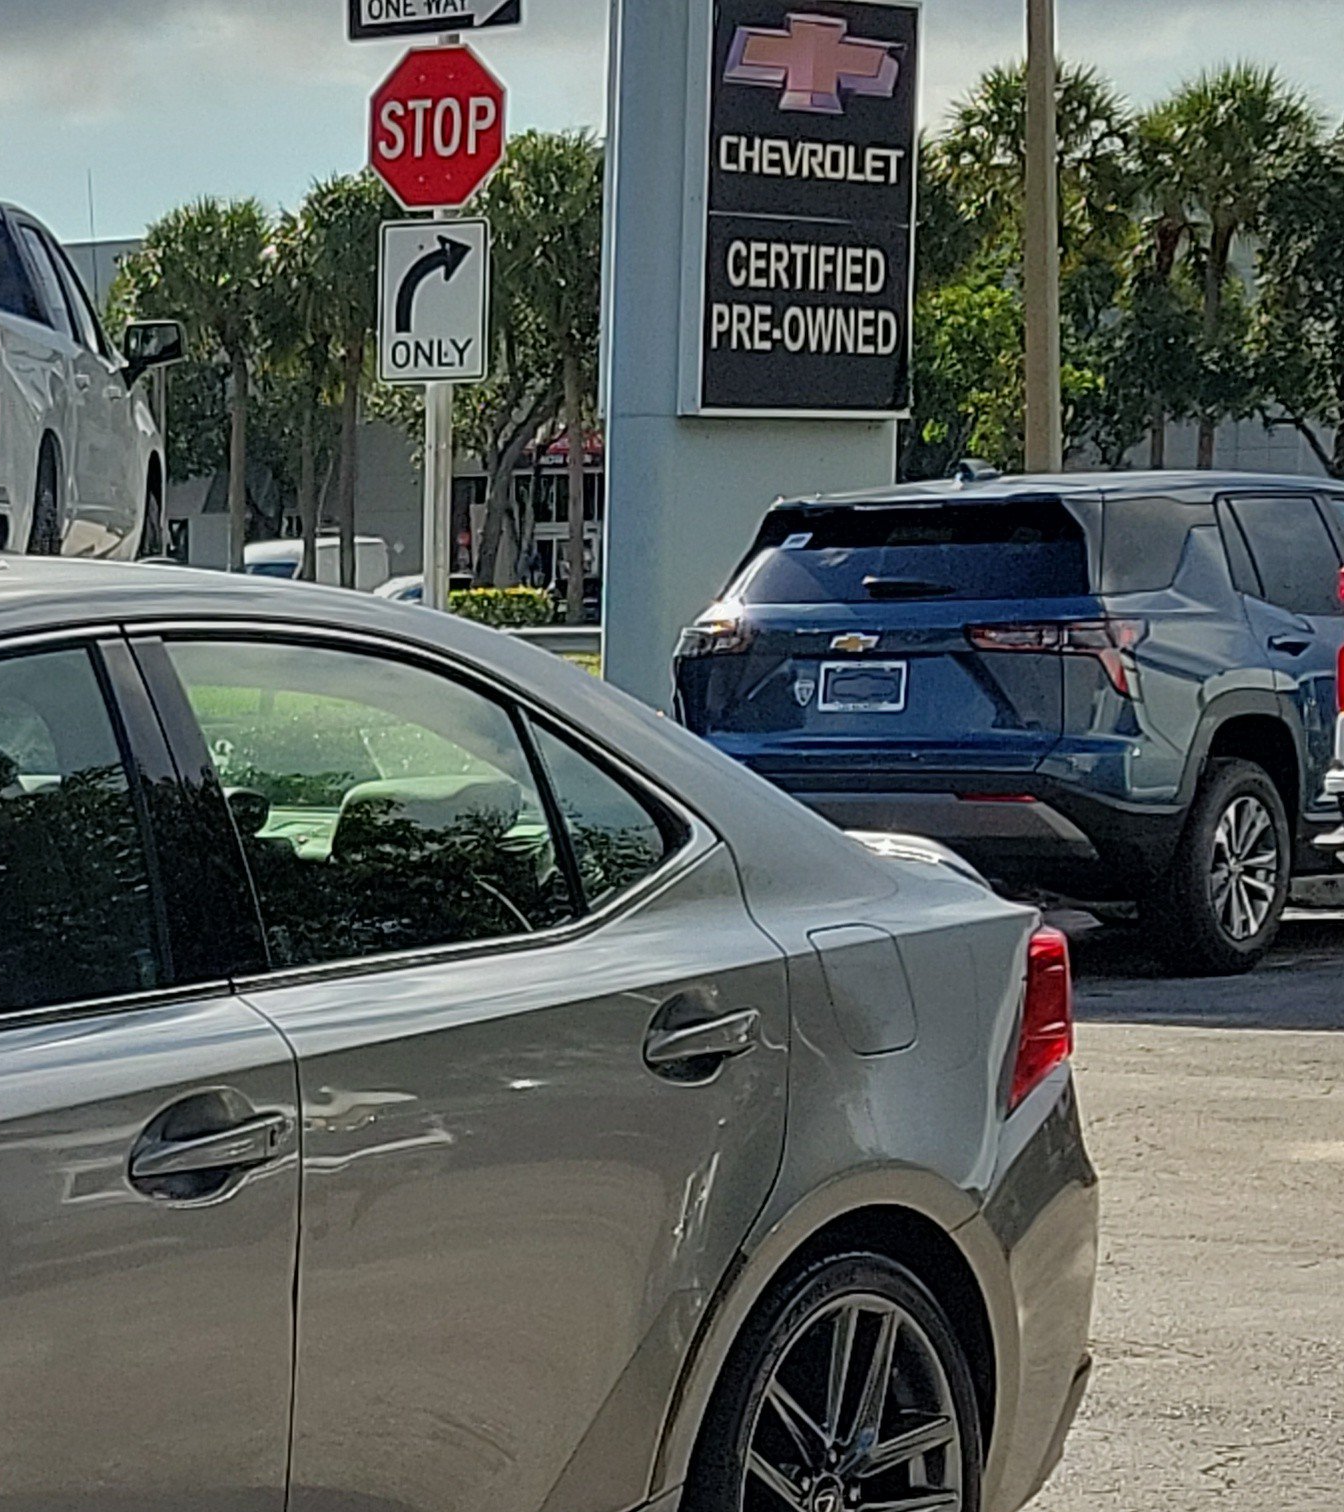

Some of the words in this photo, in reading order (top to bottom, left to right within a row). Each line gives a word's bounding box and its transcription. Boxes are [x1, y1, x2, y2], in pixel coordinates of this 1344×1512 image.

[368, 0, 416, 19] ONE
[378, 96, 496, 160] STOP
[719, 134, 906, 184] CHEVROLET
[726, 239, 886, 293] CERTIFIED
[391, 338, 473, 369] ONLY
[710, 302, 898, 355] PRE-OWNED
